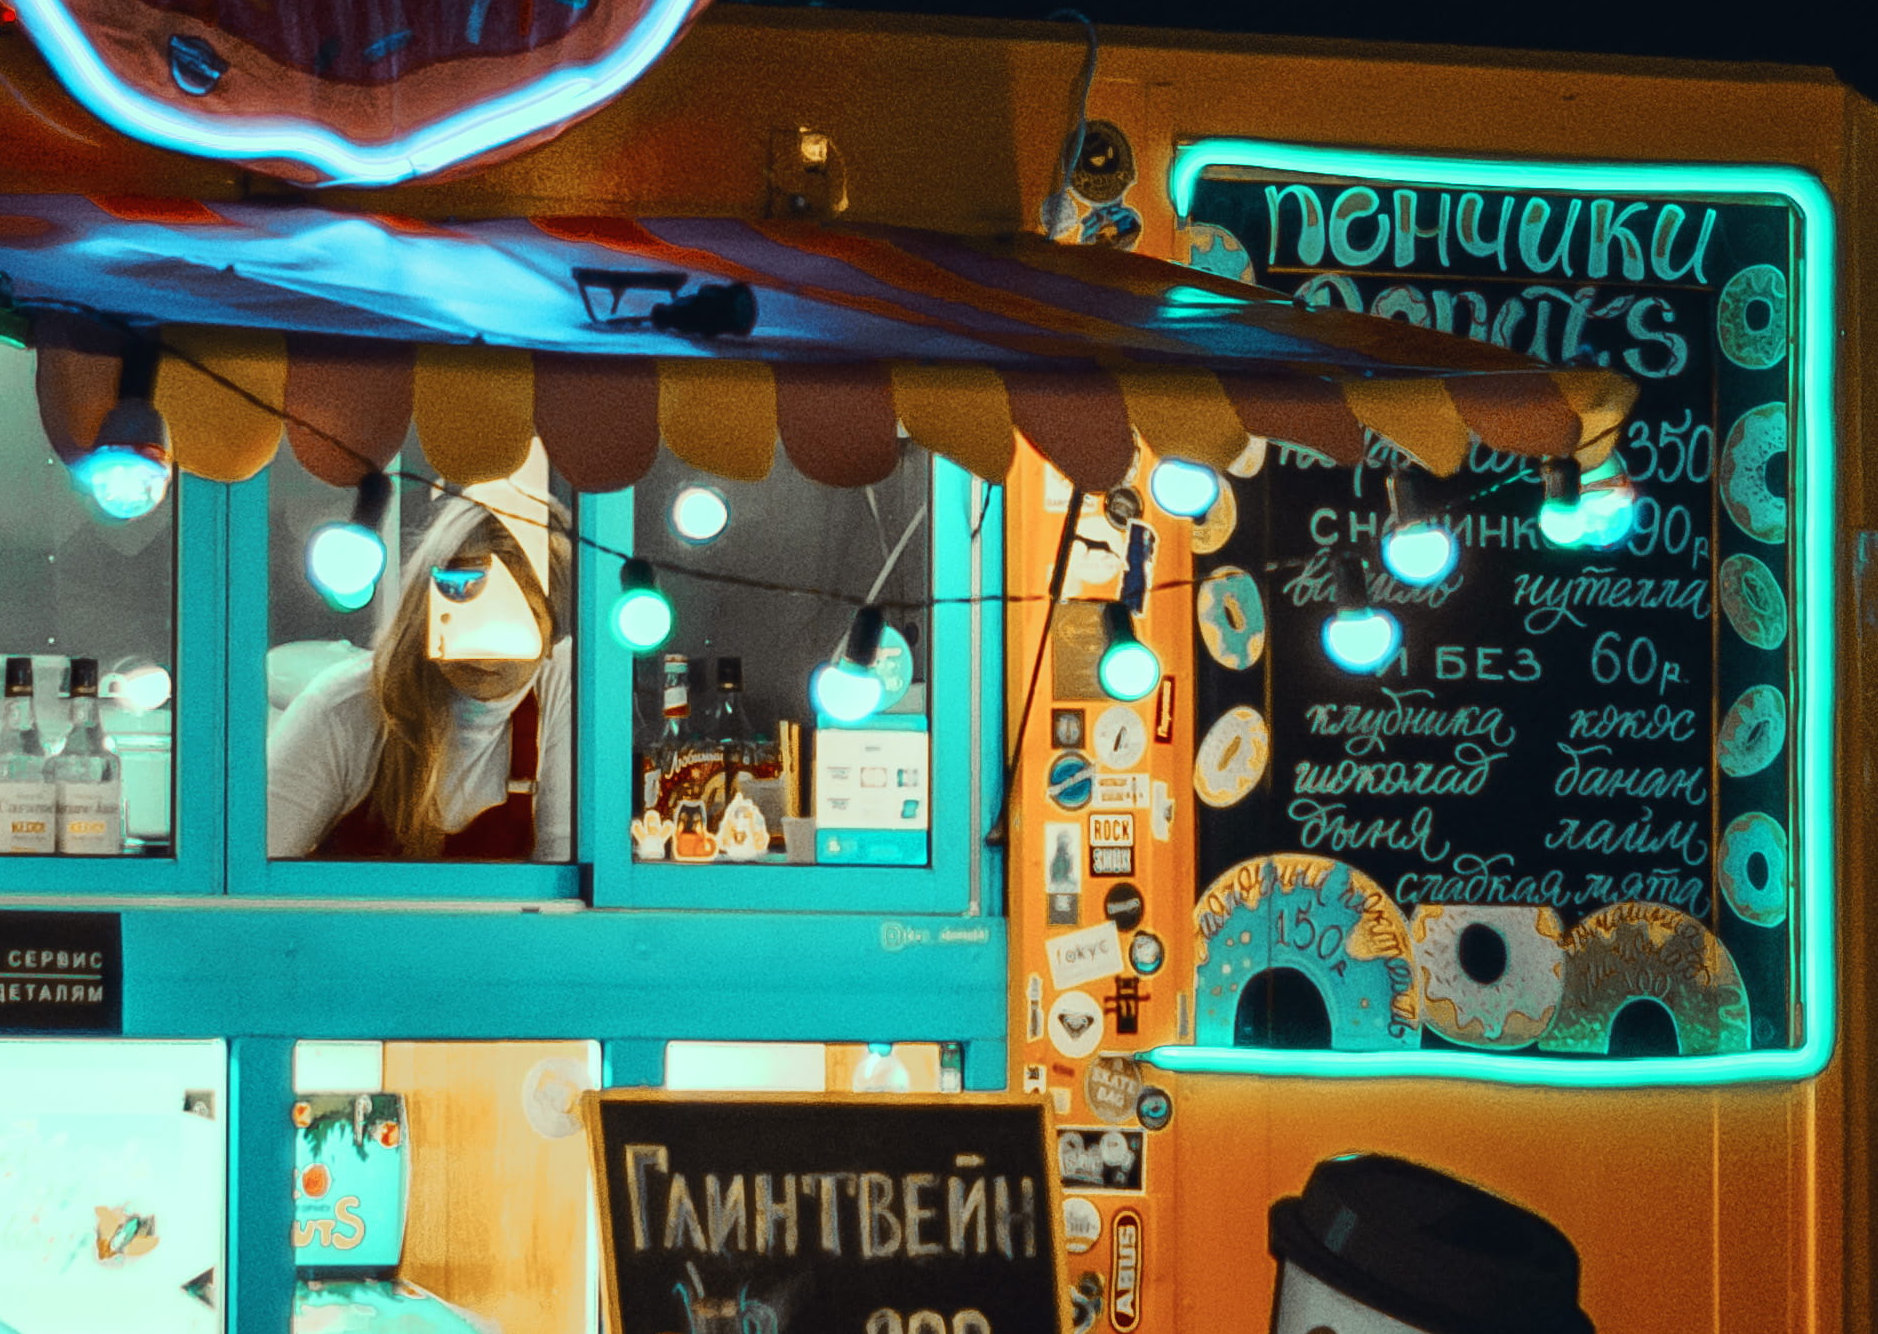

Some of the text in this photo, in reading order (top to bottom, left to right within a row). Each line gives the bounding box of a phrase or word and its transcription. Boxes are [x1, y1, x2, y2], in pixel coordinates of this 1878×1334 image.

[1513, 566, 1713, 635] нутелла
[1434, 646, 1542, 681] БЕЗ
[1306, 686, 1697, 756] клубника кокос
[1293, 741, 1708, 805] шоколад банан
[1093, 818, 1130, 842] ROCK
[1287, 798, 1709, 866] дыня лайм
[1396, 852, 1713, 919] сладкая мята
[8, 951, 103, 968] СЕРВИС
[1115, 1224, 1138, 1318] ABUS
